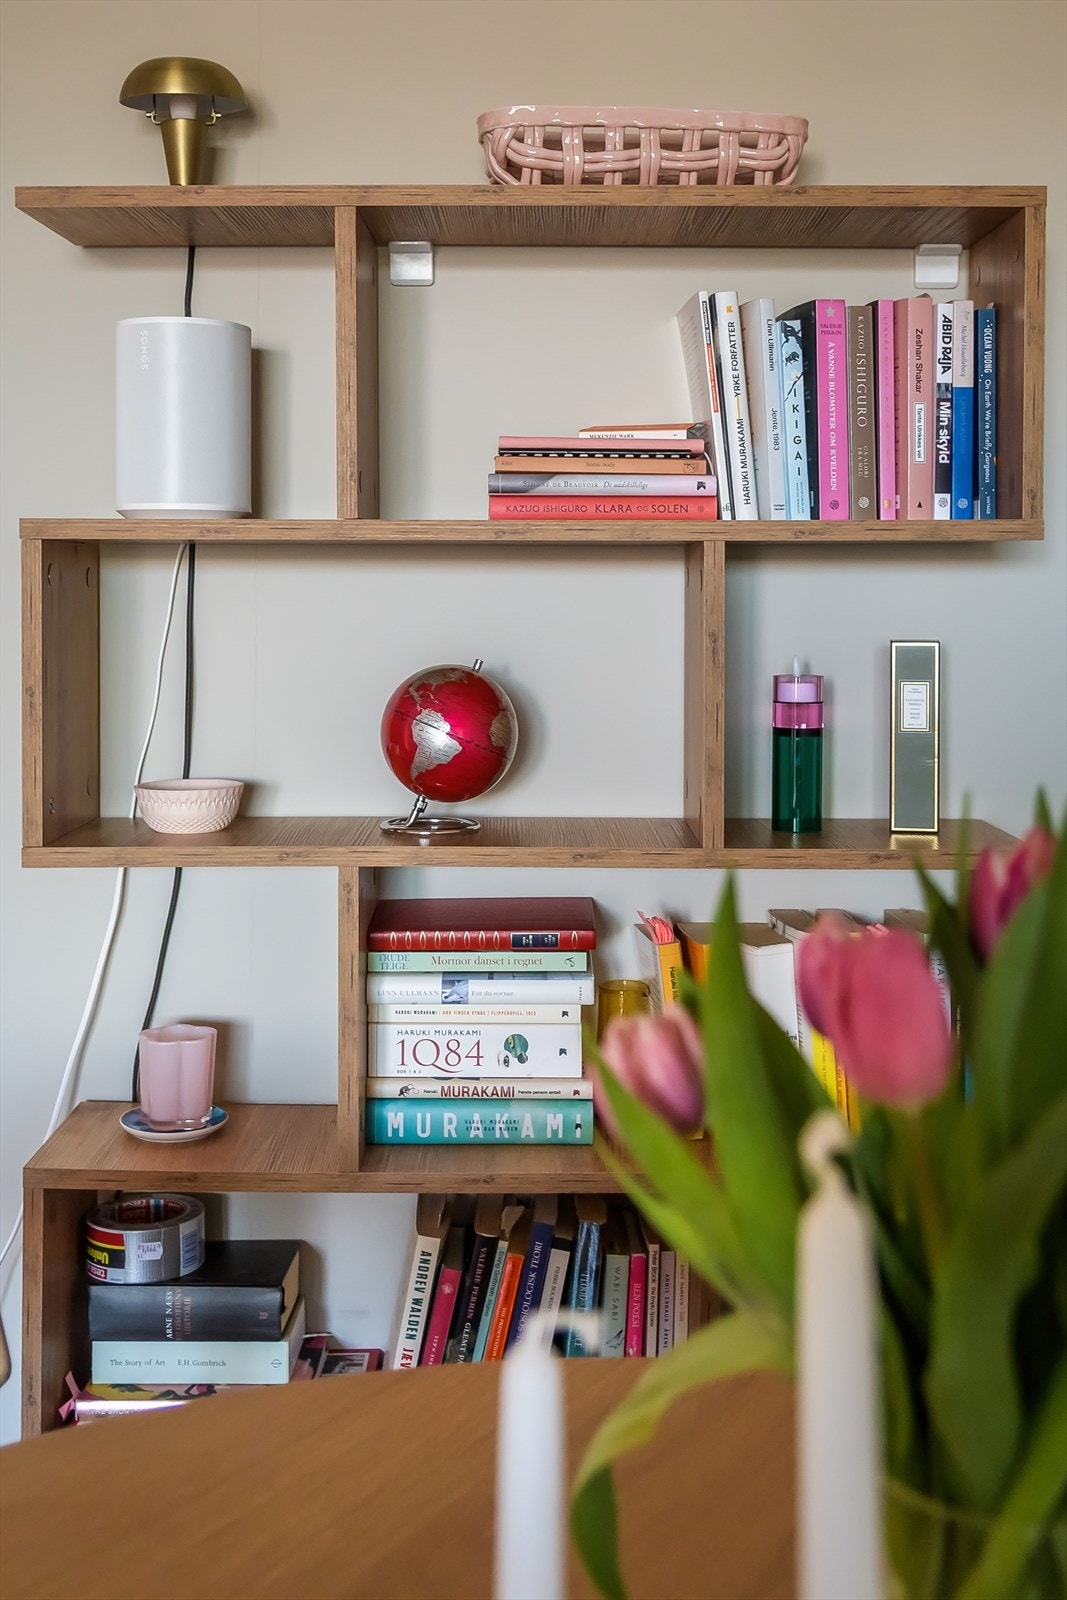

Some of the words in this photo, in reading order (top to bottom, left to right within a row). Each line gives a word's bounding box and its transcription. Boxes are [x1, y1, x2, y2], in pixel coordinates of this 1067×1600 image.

[766, 318, 775, 336] Linn
[857, 316, 865, 349] KAZUO
[942, 314, 952, 345] ABID
[984, 328, 992, 349] OCEAN
[140, 330, 148, 370] SONOS
[727, 321, 739, 372] FORFATTER
[767, 338, 776, 371] Ullmann
[915, 328, 923, 360] Zeshan
[828, 347, 836, 379] VANNE
[938, 346, 952, 375] RAJA
[984, 350, 992, 373] VUONG
[732, 373, 741, 397] YRKE
[856, 353, 868, 428] ISHIGURO
[915, 362, 923, 394] Shakar
[984, 379, 991, 390] On
[828, 382, 837, 429] BLOMSTER
[984, 391, 992, 408] Earth
[771, 408, 779, 432] Jente,
[939, 402, 951, 425] Min
[984, 409, 992, 429] We're
[737, 418, 748, 469] MURAKAMI
[772, 433, 780, 451] 1983
[792, 388, 802, 476] IKIGAI
[829, 432, 837, 447] OM
[982, 430, 992, 450] Briefly
[936, 429, 949, 463] skyld
[829, 449, 838, 491] KVELDEN
[982, 452, 991, 483] Gorgeous
[741, 471, 751, 505] HARUKI
[505, 504, 540, 513] KAZUO
[542, 504, 588, 513] ISHIGURO
[595, 504, 632, 513] KLARA
[652, 504, 689, 513] SOLEN
[379, 954, 410, 962] TRUDE
[379, 962, 408, 970] TEIGE
[431, 956, 471, 966] Mormor
[474, 956, 504, 965] danset
[508, 956, 511, 965] i
[513, 957, 542, 967] regnet
[396, 1038, 484, 1073] 1Q84
[440, 1086, 515, 1098] MURAKAMI
[387, 1112, 582, 1138] MURAKAMI
[414, 1250, 432, 1293] ANDREV
[474, 1247, 488, 1283] VALÉRIE
[495, 1250, 505, 1269] Erving
[518, 1272, 537, 1332] SOSIOLOGISK
[530, 1241, 543, 1268] TEORI
[552, 1265, 561, 1284] PIERRE
[612, 1266, 621, 1293] WABI
[466, 1286, 479, 1319] PERRIN
[632, 1283, 641, 1301] REN
[405, 1297, 423, 1340] WALDEN
[611, 1297, 620, 1321] SABI
[632, 1303, 641, 1328] POESI
[165, 1318, 173, 1339] ARNE
[459, 1322, 471, 1352] GLEMT
[125, 1359, 142, 1368] Story
[192, 1359, 227, 1367] Gombrich
[400, 1347, 414, 1369] JÆV
